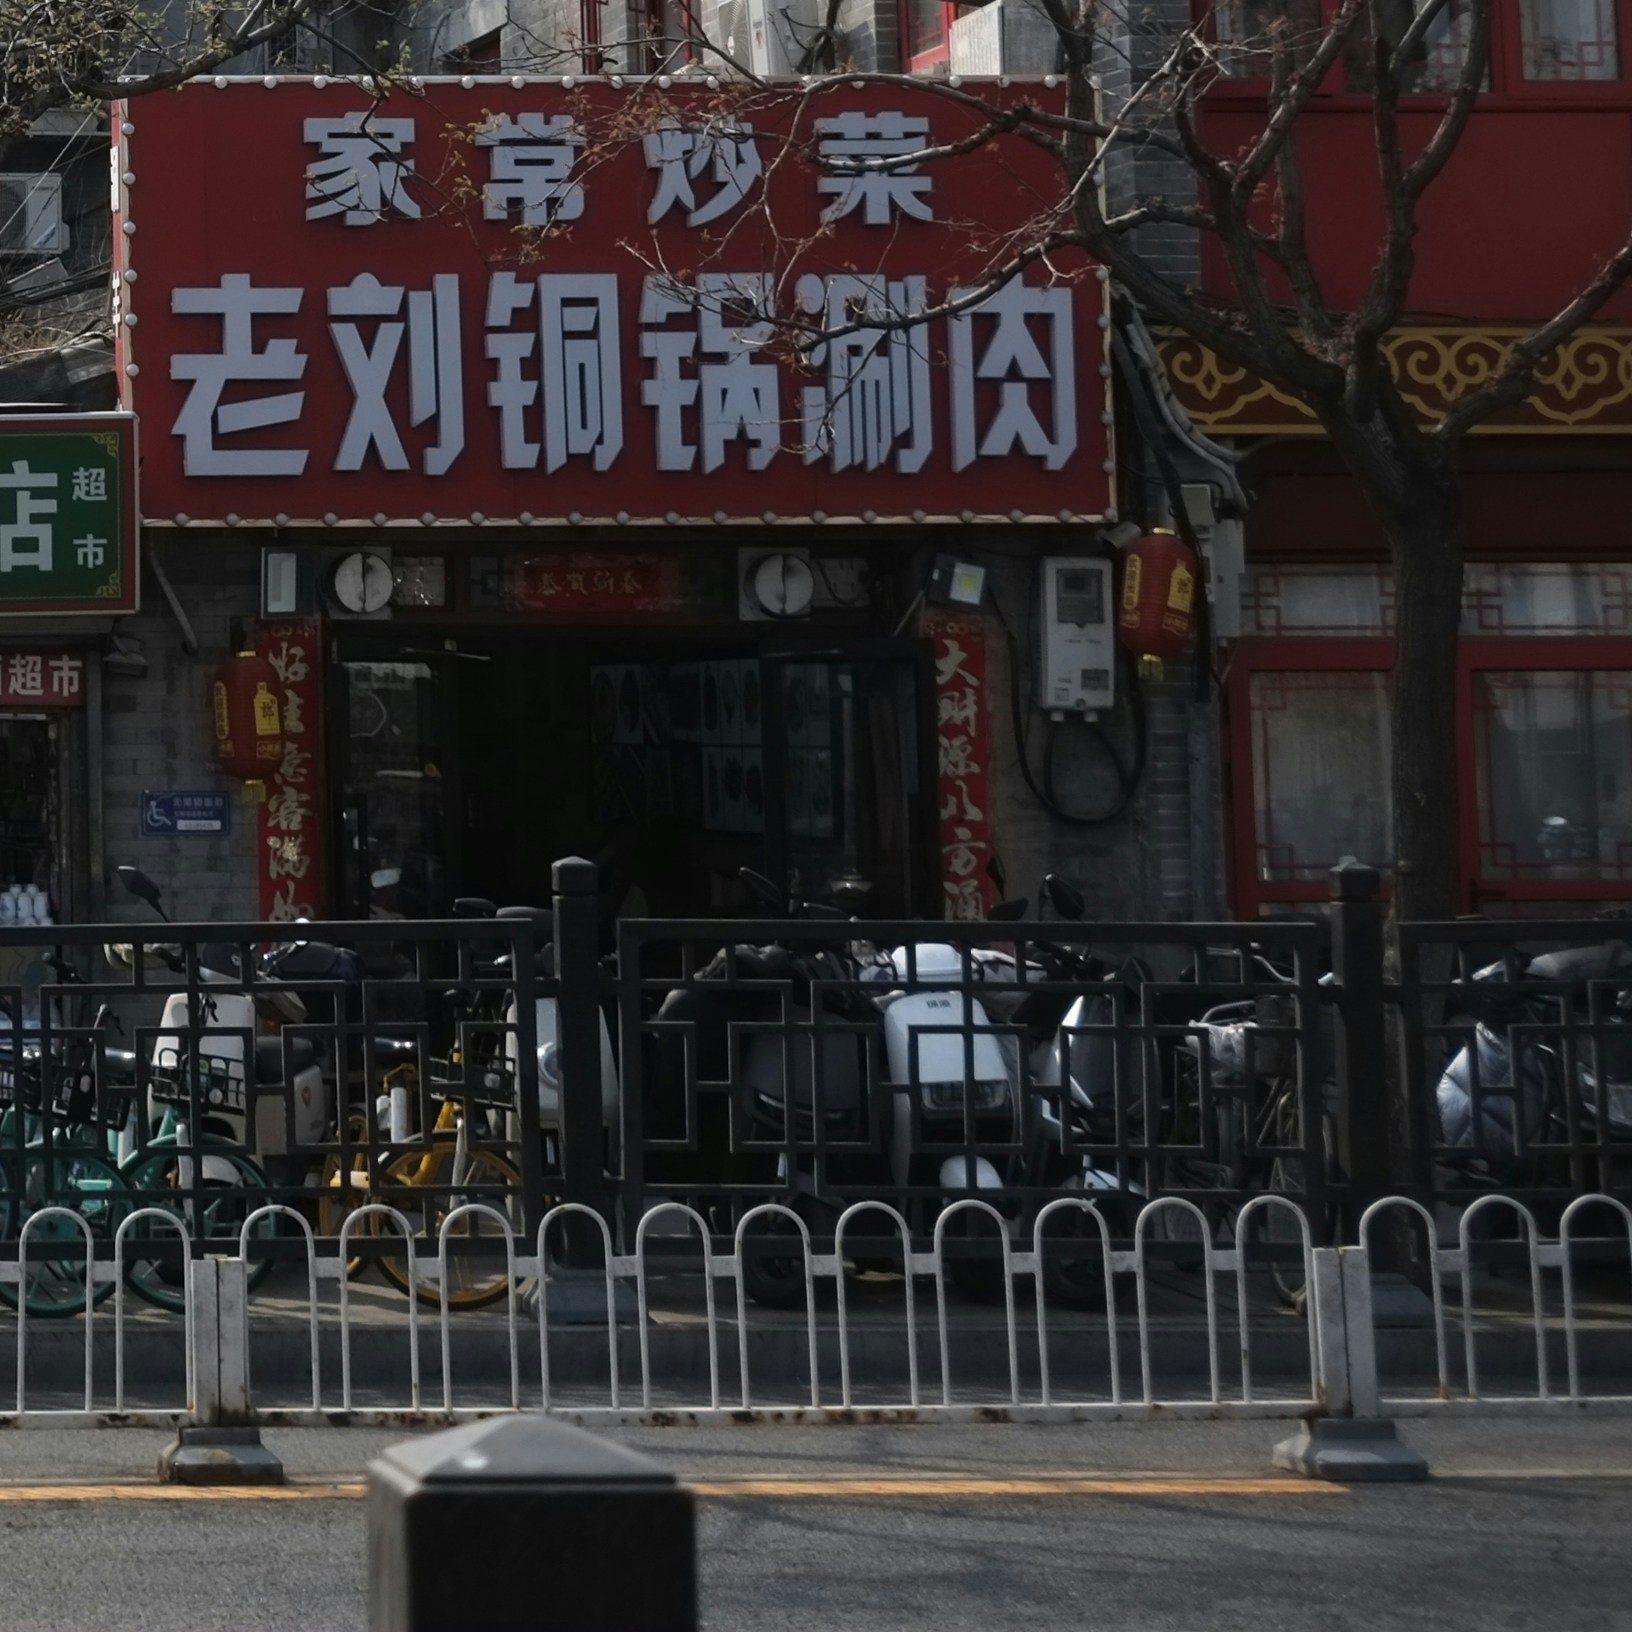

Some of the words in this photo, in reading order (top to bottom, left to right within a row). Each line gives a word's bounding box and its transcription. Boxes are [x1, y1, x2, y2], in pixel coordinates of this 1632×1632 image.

[304, 111, 934, 226] 家常炒菜
[170, 272, 1079, 477] 老刘铜锅涮肉
[71, 466, 109, 570] 超市
